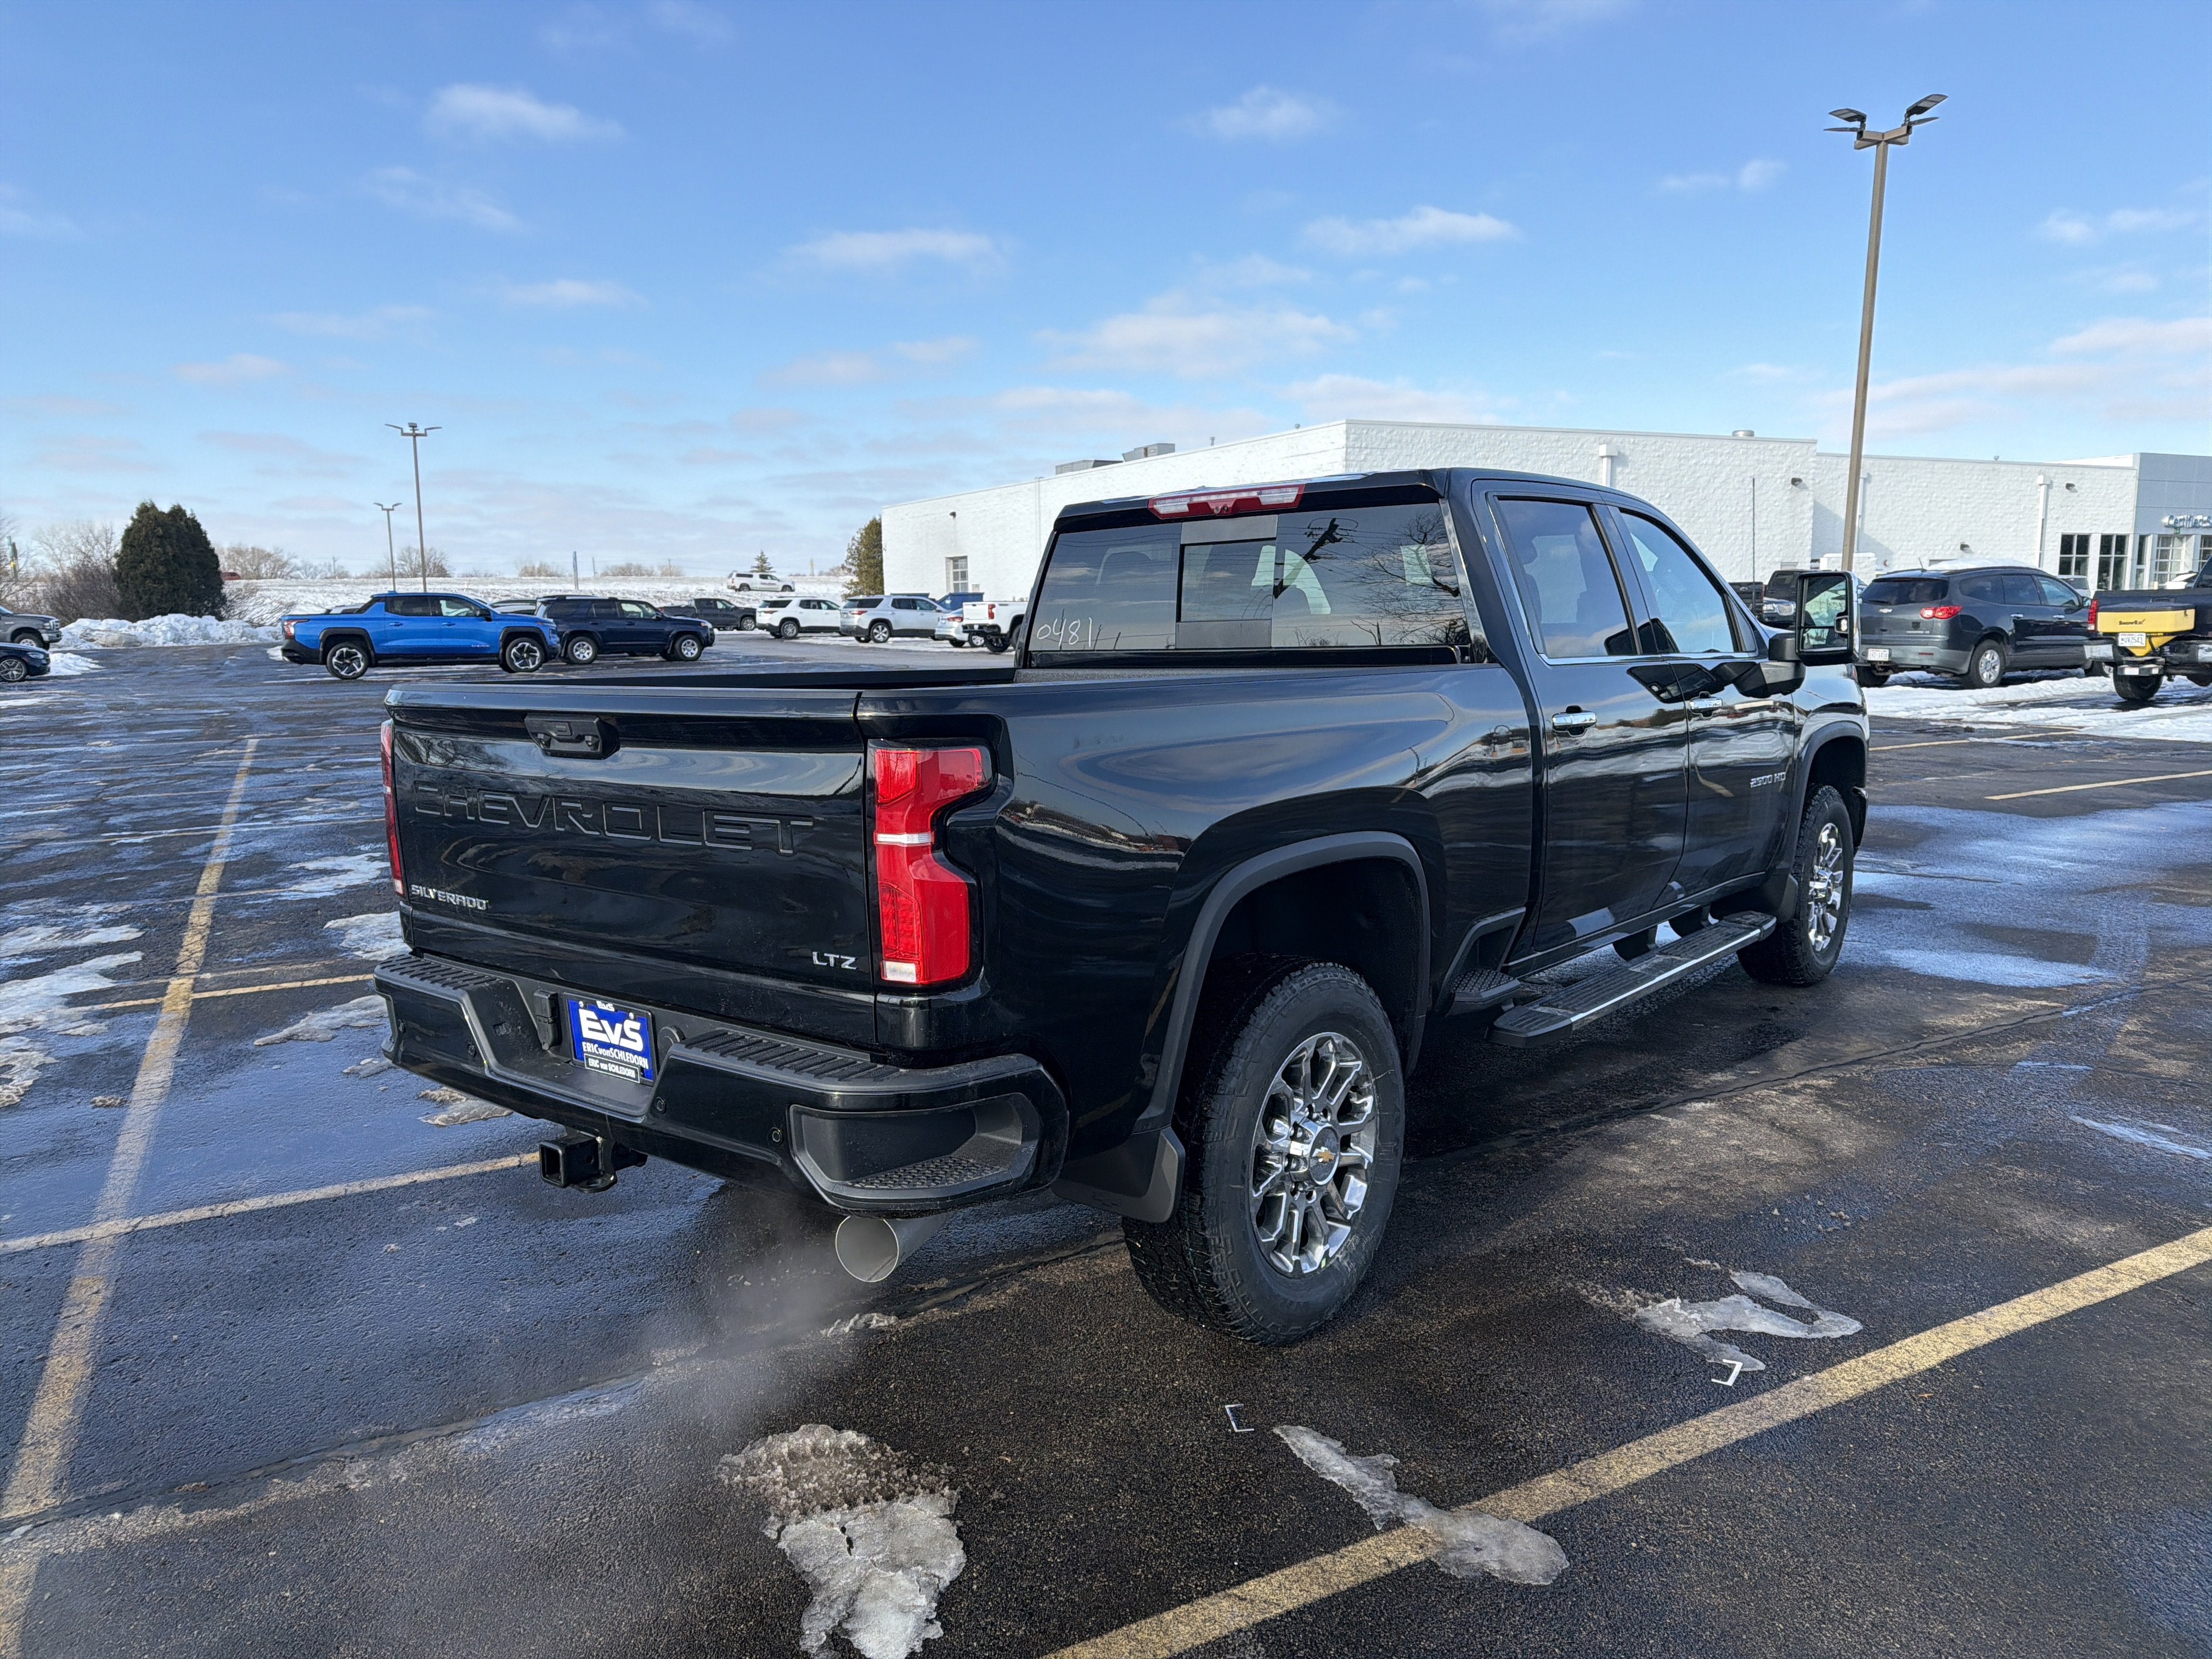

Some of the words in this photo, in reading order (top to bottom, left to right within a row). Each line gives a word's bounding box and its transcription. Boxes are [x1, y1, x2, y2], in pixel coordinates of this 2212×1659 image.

[1036, 617, 1092, 648] 0481
[1774, 772, 1786, 783] HD
[414, 781, 812, 854] CHEVROLET
[411, 884, 488, 911] SILVERADO
[812, 951, 857, 970] LTZ
[588, 1058, 600, 1068] ERIC
[608, 1063, 636, 1079] SCHLEDORN
